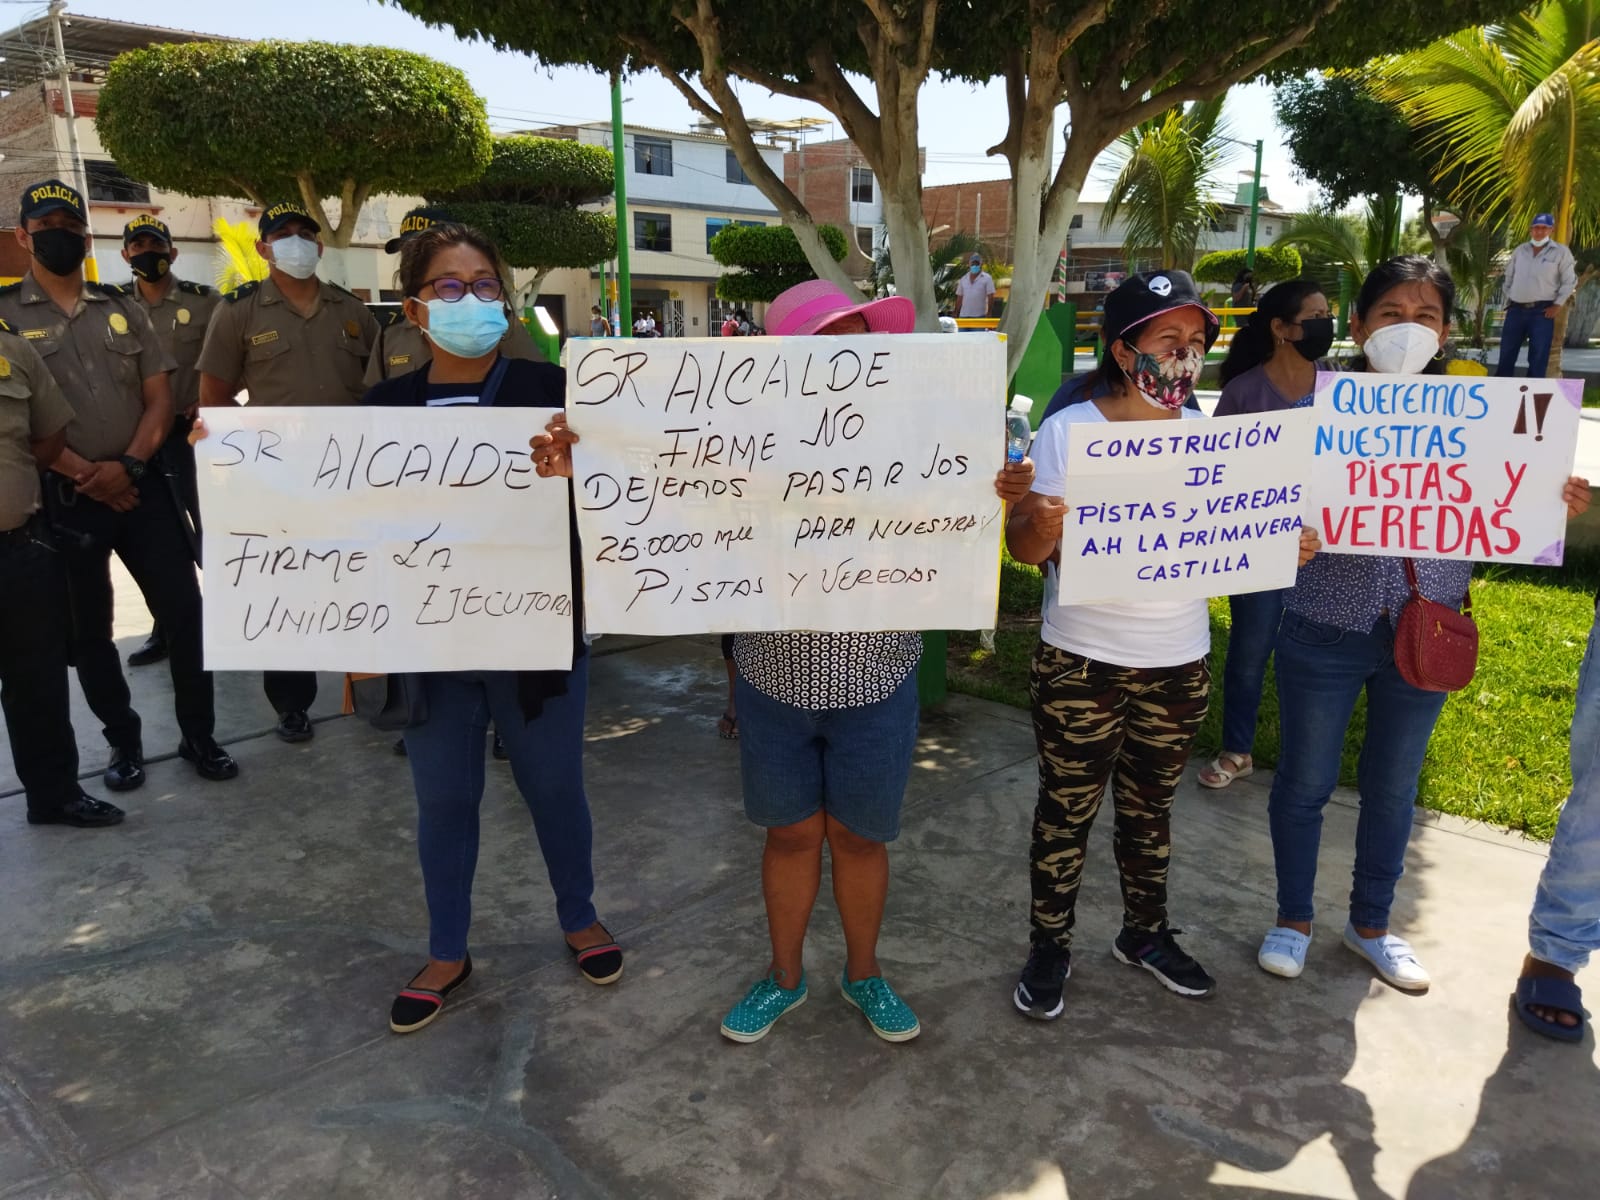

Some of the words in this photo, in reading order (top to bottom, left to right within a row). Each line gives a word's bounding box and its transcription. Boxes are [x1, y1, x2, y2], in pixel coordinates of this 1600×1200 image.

[30, 185, 81, 209] POLICIA
[128, 215, 165, 233] POLICIA
[575, 348, 648, 407] SR
[800, 403, 864, 447] NO
[1087, 421, 1281, 457] CONSTRUCIÓN
[1315, 425, 1466, 458] NUESTRAS
[213, 430, 281, 466] SR
[581, 473, 747, 525] DEJEMOS
[783, 461, 903, 502] PASAR
[1185, 464, 1226, 486] DE
[1207, 484, 1301, 515] VEREDAS
[795, 516, 855, 549] PARA
[1138, 533, 1168, 552] LA
[1177, 514, 1304, 549] PRIMAVERA
[1322, 504, 1520, 557] VEREDAS
[788, 573, 807, 596] Y
[822, 558, 937, 593] VEREDAS
[1137, 553, 1249, 582] CASTILLA
[244, 597, 389, 641] UNIDAD
